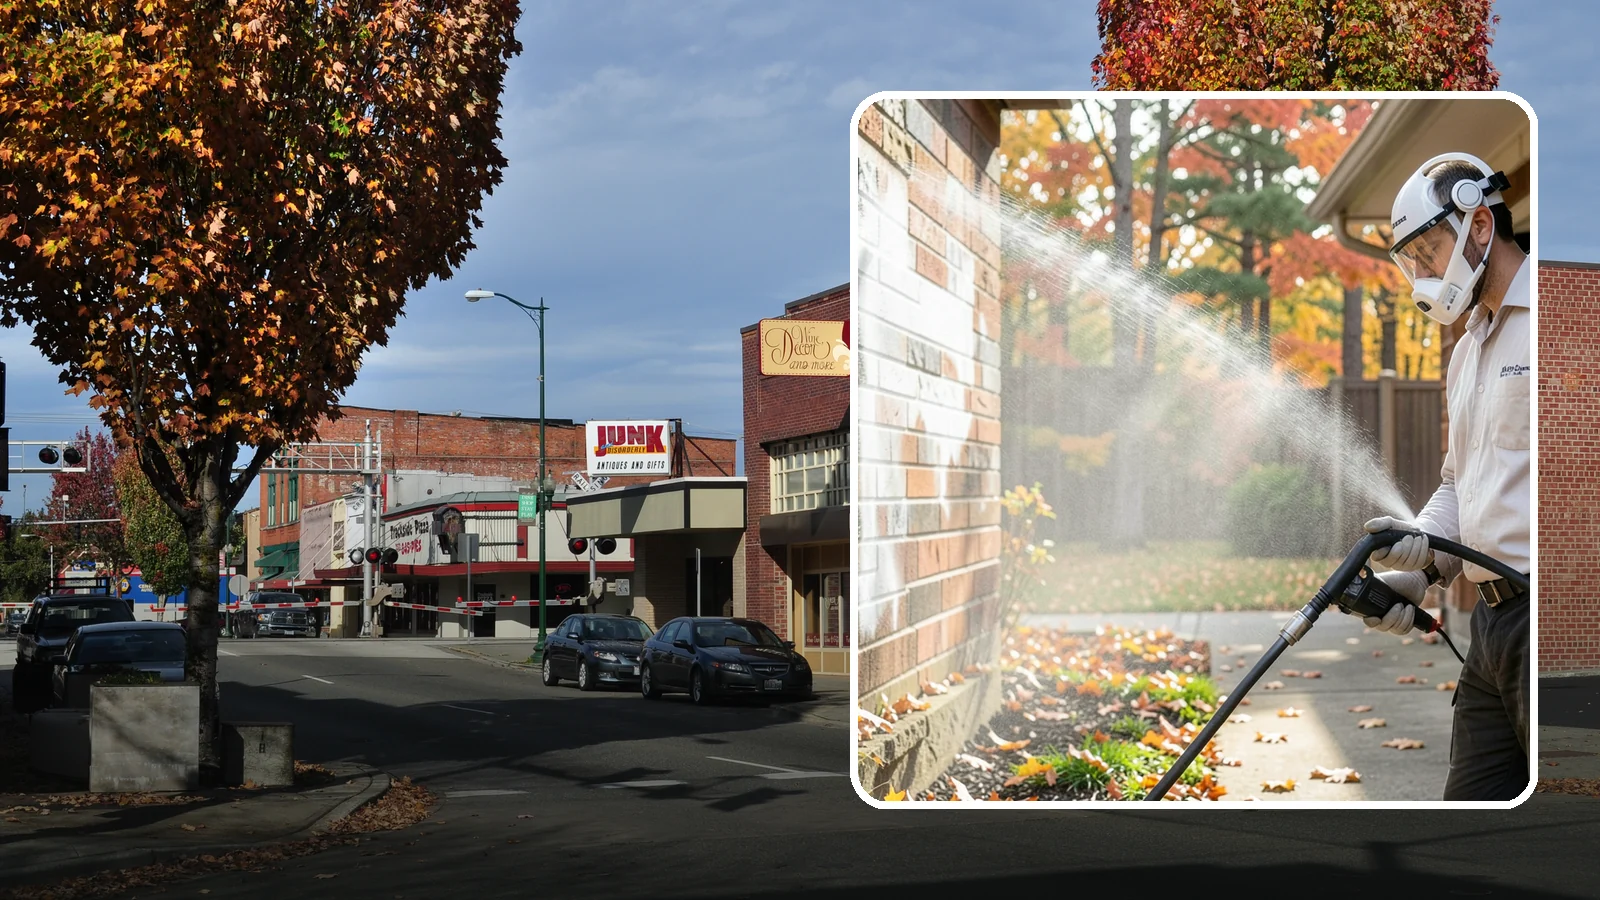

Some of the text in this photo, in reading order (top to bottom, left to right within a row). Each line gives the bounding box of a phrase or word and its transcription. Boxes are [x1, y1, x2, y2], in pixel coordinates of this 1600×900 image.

[765, 328, 830, 365] Decor
[595, 425, 666, 457] JUNK
[597, 460, 665, 470] ANTIQUES AND GIFTS
[590, 476, 608, 491] SING
[352, 498, 364, 510] CRO
[390, 519, 429, 539] Trackside Pizza
